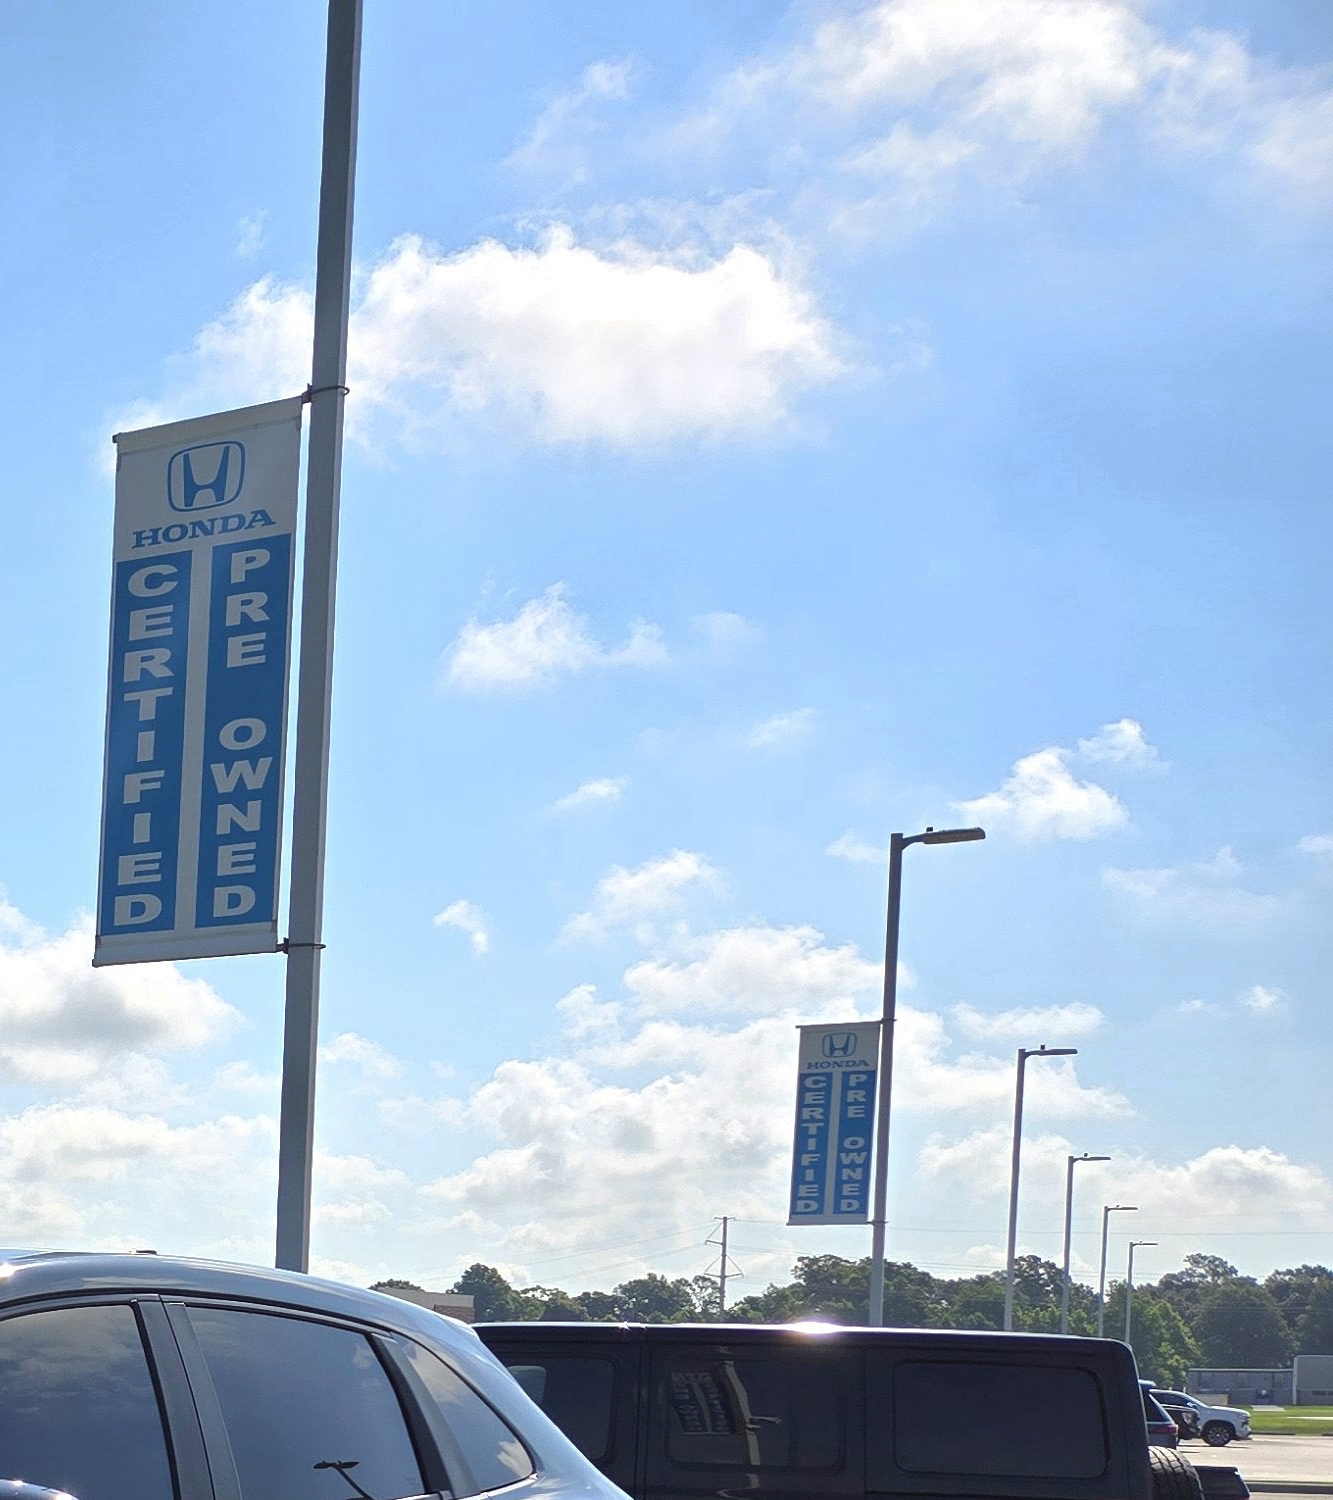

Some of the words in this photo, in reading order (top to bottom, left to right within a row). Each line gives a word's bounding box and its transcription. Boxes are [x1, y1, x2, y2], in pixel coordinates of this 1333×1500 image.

[132, 508, 276, 549] HONDA
[225, 548, 271, 669] PRE
[113, 563, 179, 928] CERTIFIED
[210, 716, 274, 919] OWNED
[806, 1059, 870, 1070] HONDA
[846, 1074, 868, 1119] PRE
[796, 1075, 828, 1213] CERTIFIED
[839, 1136, 868, 1212] OWNED
